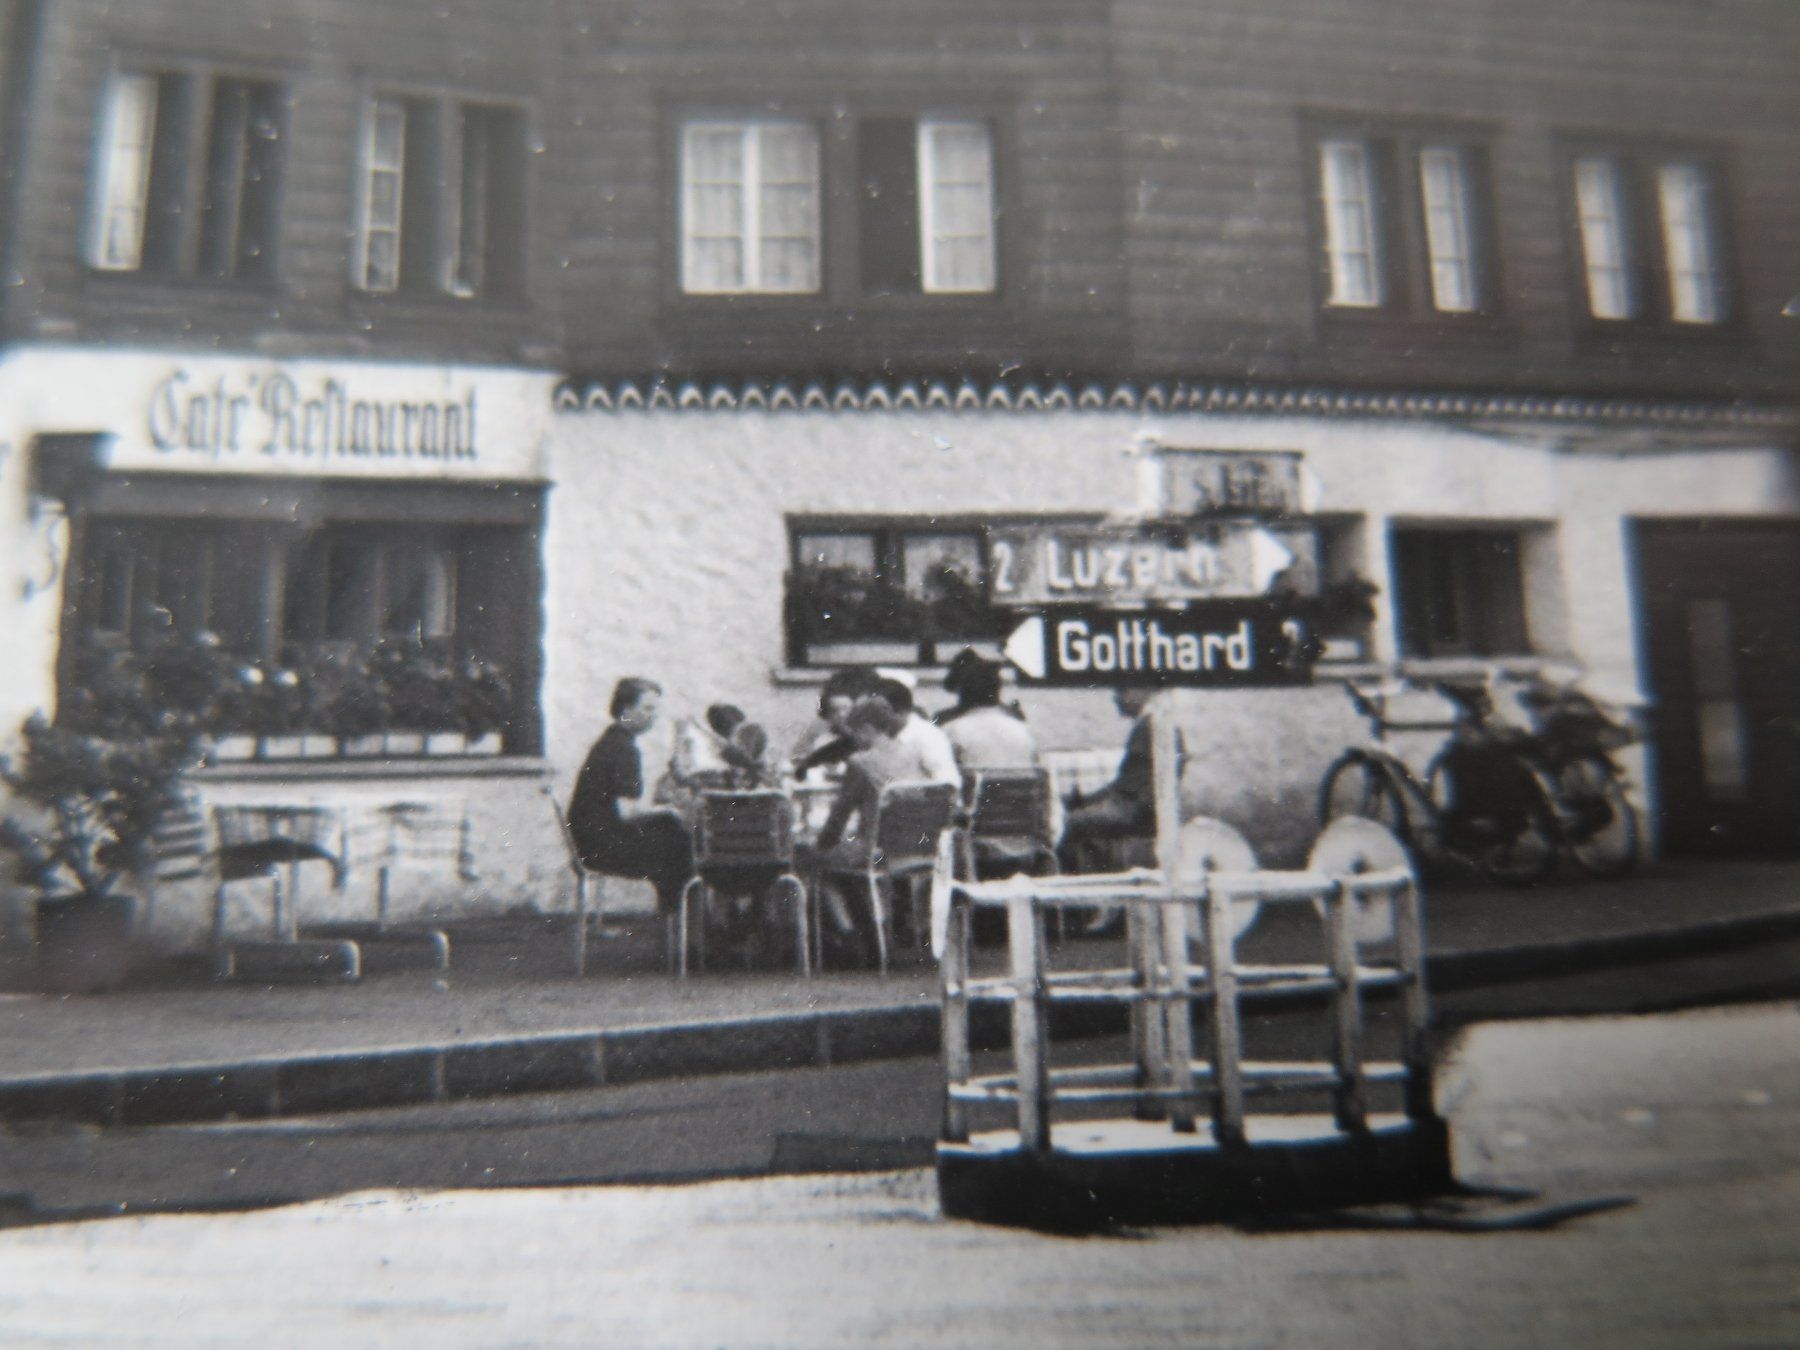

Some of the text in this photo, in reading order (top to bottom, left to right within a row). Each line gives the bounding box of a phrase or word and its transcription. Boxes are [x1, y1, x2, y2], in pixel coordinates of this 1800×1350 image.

[260, 371, 477, 461] Restaurant
[993, 539, 1218, 592] 2 Luzern
[1057, 619, 1252, 672] Gotthard
